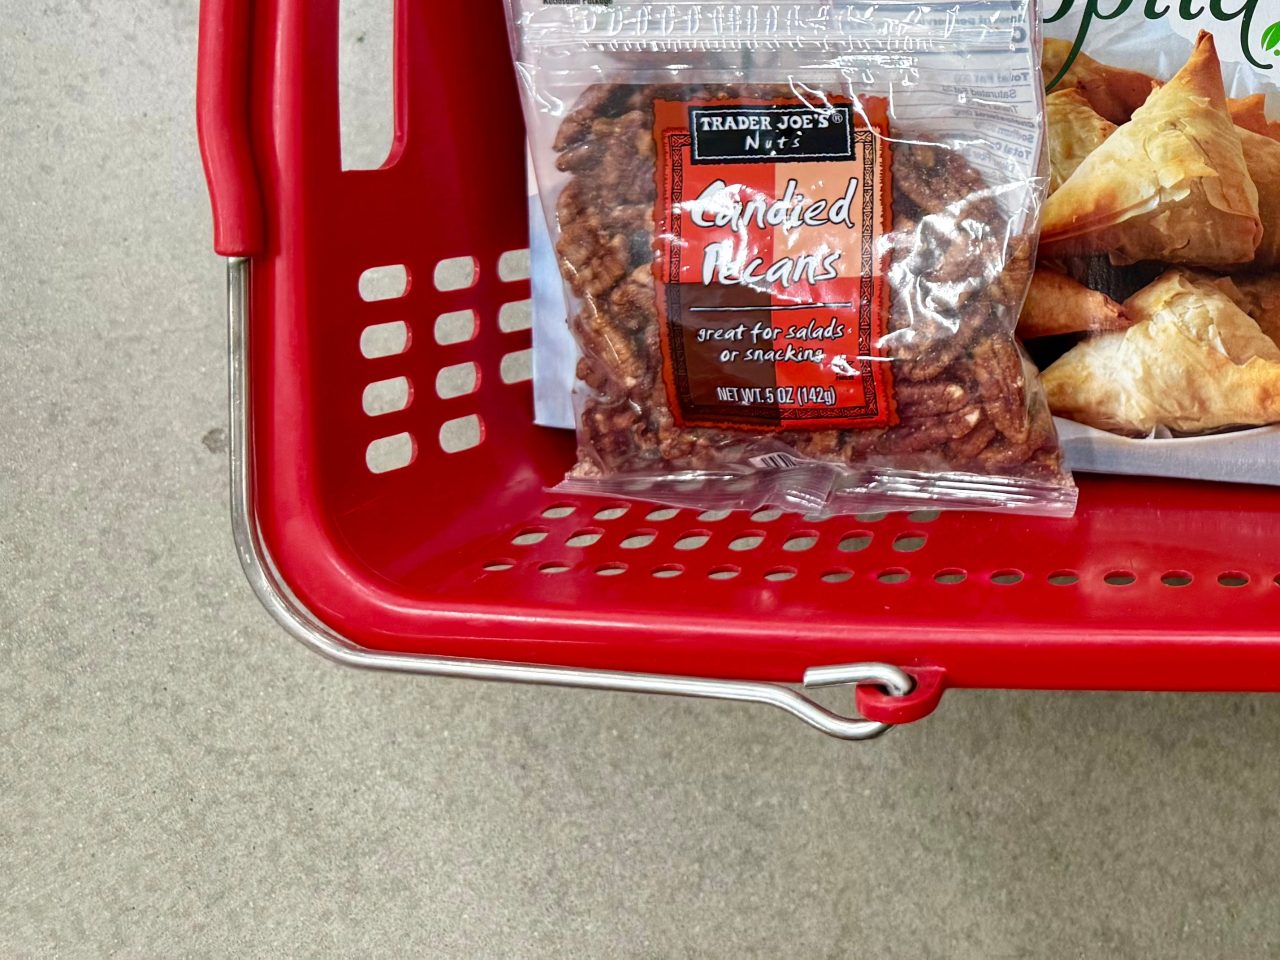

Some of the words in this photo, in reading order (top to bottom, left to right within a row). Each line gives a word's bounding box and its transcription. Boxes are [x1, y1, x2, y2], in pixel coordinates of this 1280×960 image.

[699, 115, 773, 132] TRADER
[775, 114, 830, 130] JOE'S
[744, 131, 801, 152] Nuts
[690, 176, 859, 233] Candied
[701, 239, 842, 288] Pecans
[697, 324, 748, 343] great
[750, 321, 783, 344] for
[784, 317, 846, 340] salads
[719, 349, 741, 363] or
[742, 344, 826, 364] snacking
[716, 386, 740, 403] NET
[741, 386, 765, 405] WT.
[766, 387, 776, 403] 5
[777, 386, 794, 404] OZ
[796, 386, 837, 406] (142g)
